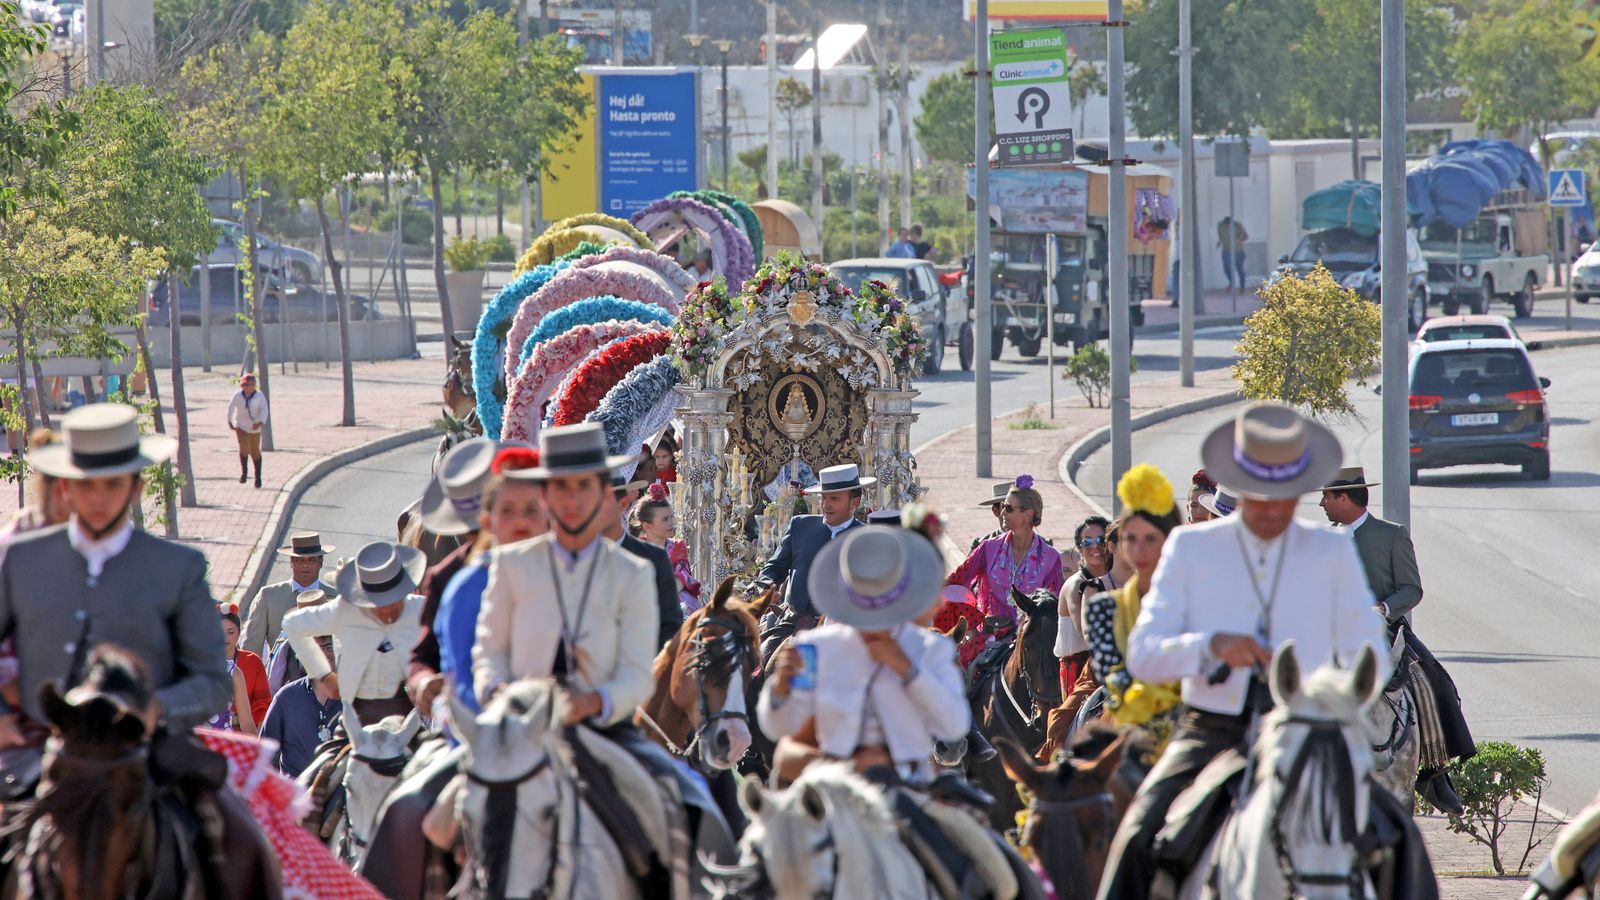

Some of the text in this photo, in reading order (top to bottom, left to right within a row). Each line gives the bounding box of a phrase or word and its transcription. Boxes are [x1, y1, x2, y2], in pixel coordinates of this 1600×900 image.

[992, 36, 1062, 50] Tiendanimal
[609, 95, 627, 110] Hej
[609, 110, 677, 124] Hasta pronto
[1015, 136, 1031, 144] LUZ
[1031, 133, 1070, 143] SHOPPING
